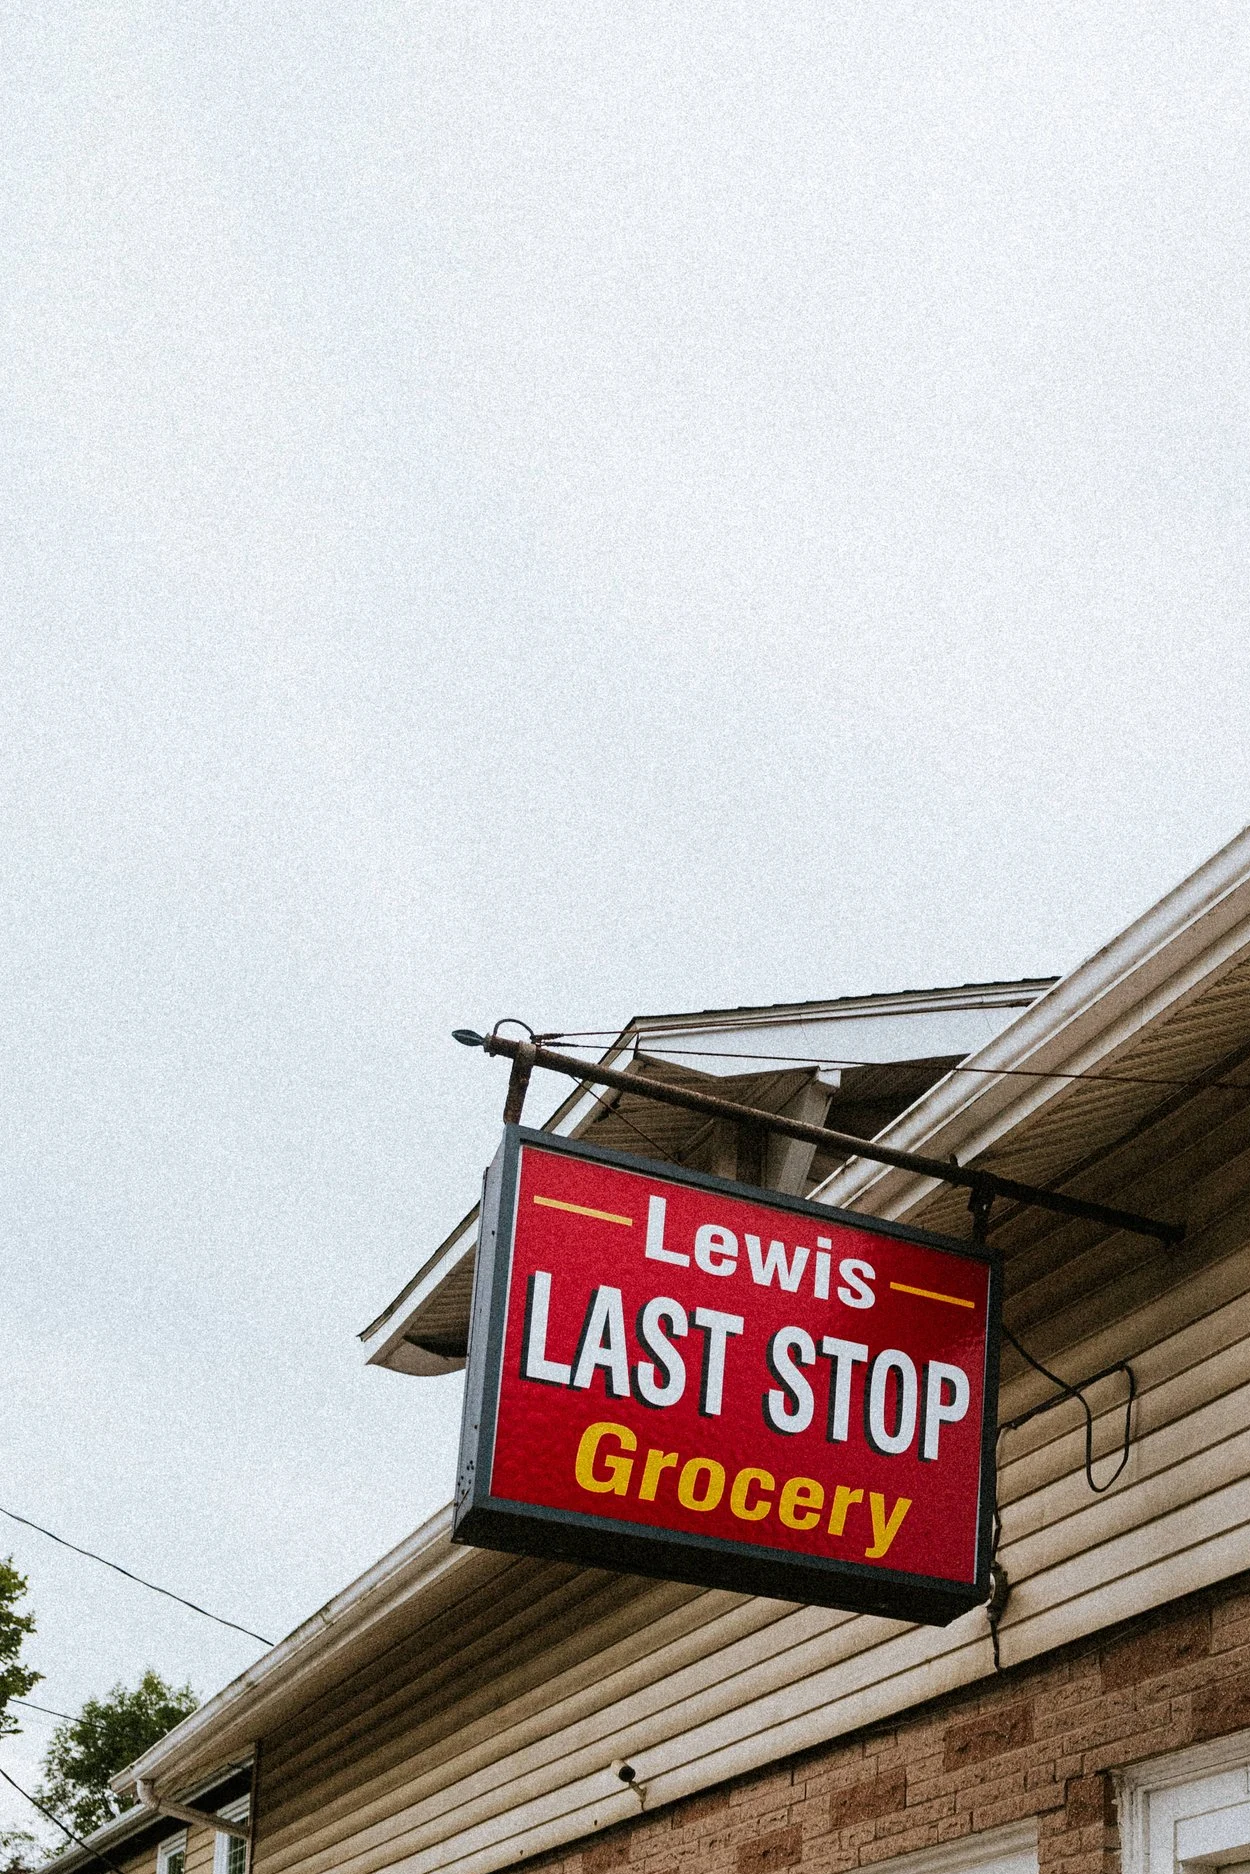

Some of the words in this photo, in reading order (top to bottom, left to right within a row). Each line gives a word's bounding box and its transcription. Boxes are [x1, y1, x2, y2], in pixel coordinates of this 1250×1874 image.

[645, 1195, 876, 1309] Lewis
[521, 1270, 745, 1415] LAST
[764, 1325, 971, 1462] STOP
[575, 1421, 913, 1559] Grocery
